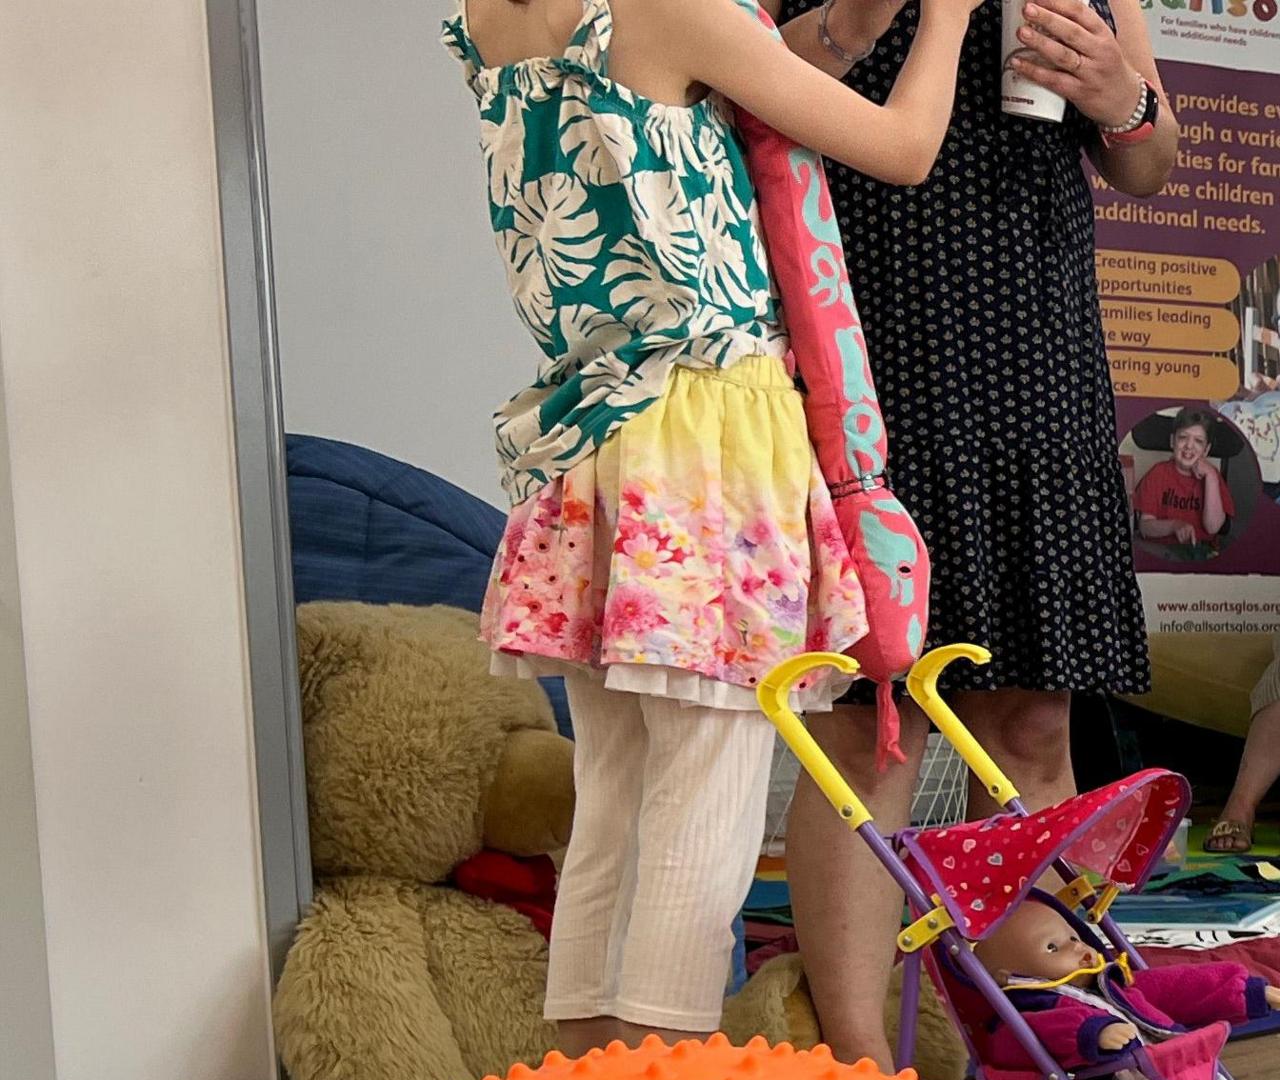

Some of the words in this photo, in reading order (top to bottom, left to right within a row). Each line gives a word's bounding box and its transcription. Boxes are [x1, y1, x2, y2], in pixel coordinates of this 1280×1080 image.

[1160, 16, 1174, 26] For
[1176, 17, 1208, 30] families
[1210, 22, 1226, 32] who
[1229, 25, 1247, 35] have
[1249, 28, 1280, 40] children
[1161, 27, 1178, 38] with
[1180, 30, 1222, 43] additional
[1223, 36, 1247, 46] needs
[1175, 94, 1259, 117] provides
[1220, 128, 1232, 143] a
[1218, 153, 1246, 174] for
[1195, 181, 1274, 206] children
[1094, 202, 1198, 229] additional
[1203, 214, 1267, 234] needs.
[1160, 261, 1217, 276] positive
[1096, 279, 1193, 296] pportunities
[1099, 306, 1153, 322] amilies
[1157, 308, 1211, 329] leading
[1120, 332, 1151, 346] way
[1155, 361, 1200, 378] young
